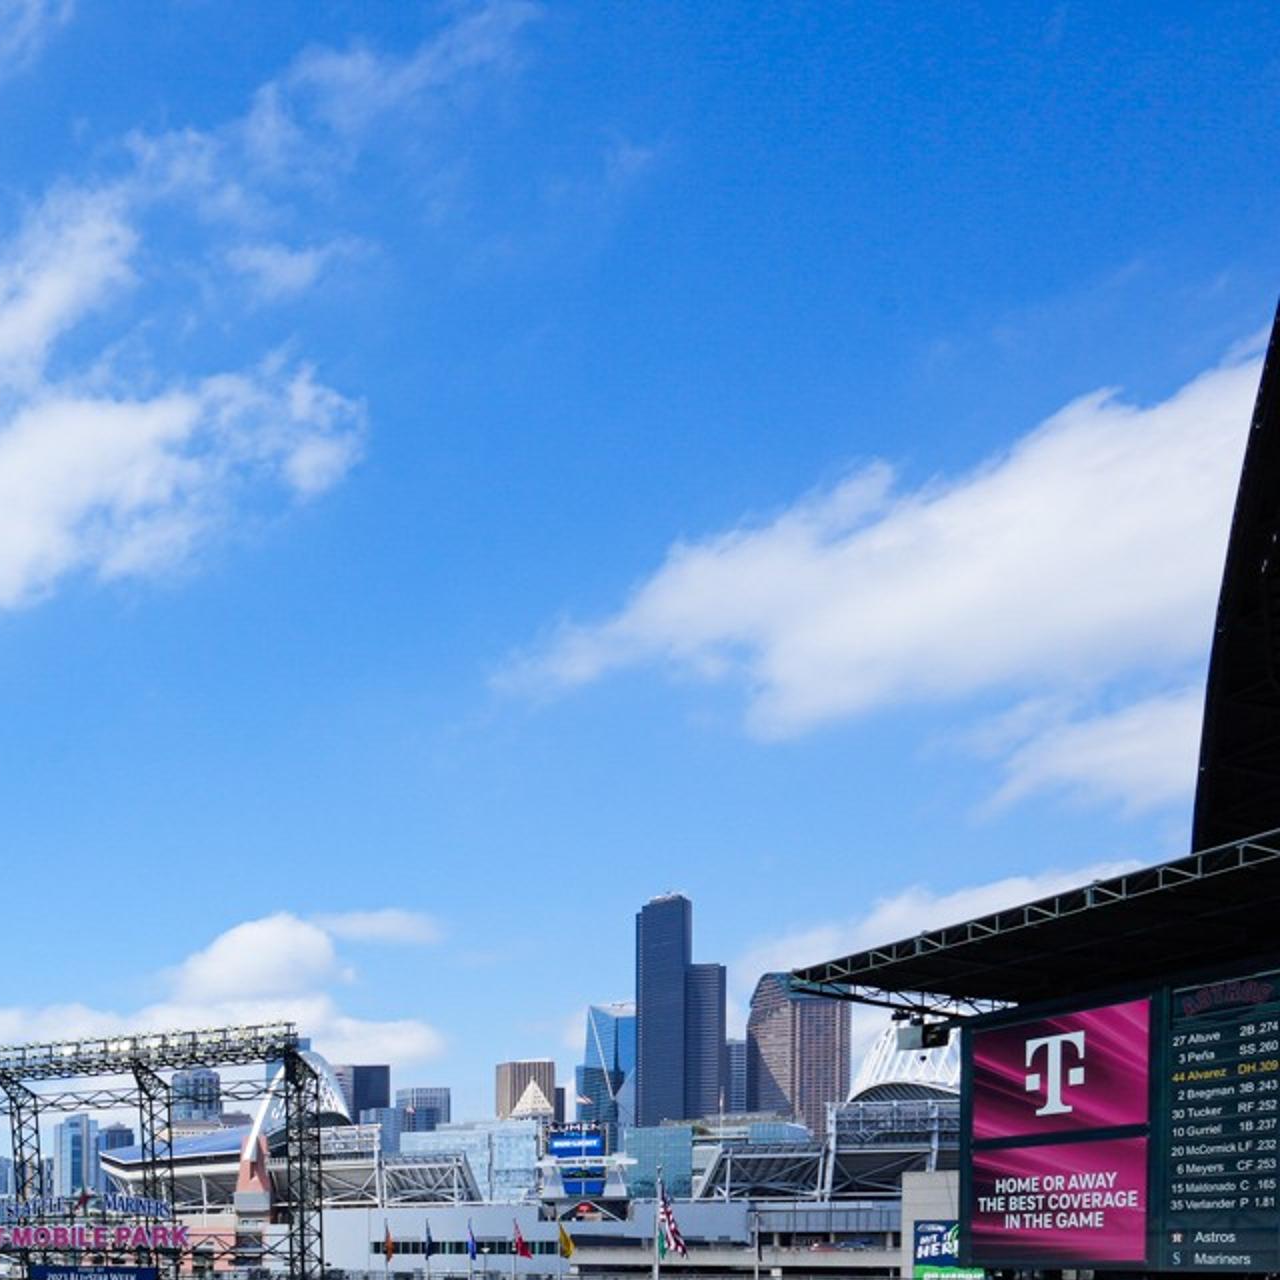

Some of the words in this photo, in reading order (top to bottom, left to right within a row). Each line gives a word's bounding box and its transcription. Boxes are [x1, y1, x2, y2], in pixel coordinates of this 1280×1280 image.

[1172, 1035, 1186, 1047] 27
[1187, 1032, 1221, 1044] Altuve
[1240, 1024, 1255, 1037] 2B
[1258, 1021, 1279, 1034] .274
[1178, 1053, 1186, 1065] 3
[1188, 1050, 1215, 1062] Peña
[1239, 1043, 1256, 1055] SS
[1259, 1040, 1279, 1053] .260
[1025, 1030, 1085, 1116] T
[1172, 1072, 1185, 1082] 44
[1187, 1068, 1228, 1080] Alvarez
[1237, 1063, 1256, 1075] DH
[1178, 1090, 1185, 1101] 2
[1187, 1086, 1235, 1100] Bregman
[1239, 1082, 1255, 1094] 3B
[1171, 1109, 1185, 1120] 30
[1187, 1106, 1222, 1118] Tucker
[1238, 1102, 1254, 1113] RF
[1172, 1127, 1184, 1138] 10
[1186, 1124, 1222, 1137] Gurriel
[1239, 1121, 1254, 1132] 1B
[1171, 1146, 1184, 1157] 20
[1186, 1143, 1236, 1156] McCormick
[1238, 1141, 1253, 1152] LF
[1176, 1164, 1184, 1174] 6
[1186, 1163, 1224, 1175] Meyers
[1236, 1160, 1253, 1171] CF
[995, 1177, 1039, 1194] HOME
[1043, 1175, 1064, 1191] OR
[1068, 1172, 1117, 1190] AWAY
[1172, 1183, 1184, 1193] 15
[1186, 1182, 1236, 1193] Maldonado
[1240, 1180, 1249, 1190] C
[104, 1193, 173, 1217] MARINERS
[978, 1196, 1005, 1212] THE
[1009, 1195, 1044, 1211] BEST
[1047, 1190, 1138, 1209] COVERAGE
[1170, 1200, 1184, 1210] 35
[1186, 1198, 1236, 1210] Verlander
[1240, 1197, 1249, 1207] P
[1005, 1213, 1020, 1229] IN
[1024, 1213, 1052, 1229] THE
[1056, 1212, 1104, 1228] GAME
[114, 1225, 190, 1247] PARK
[1194, 1231, 1236, 1243] Astros
[1194, 1252, 1251, 1265] Mariners
